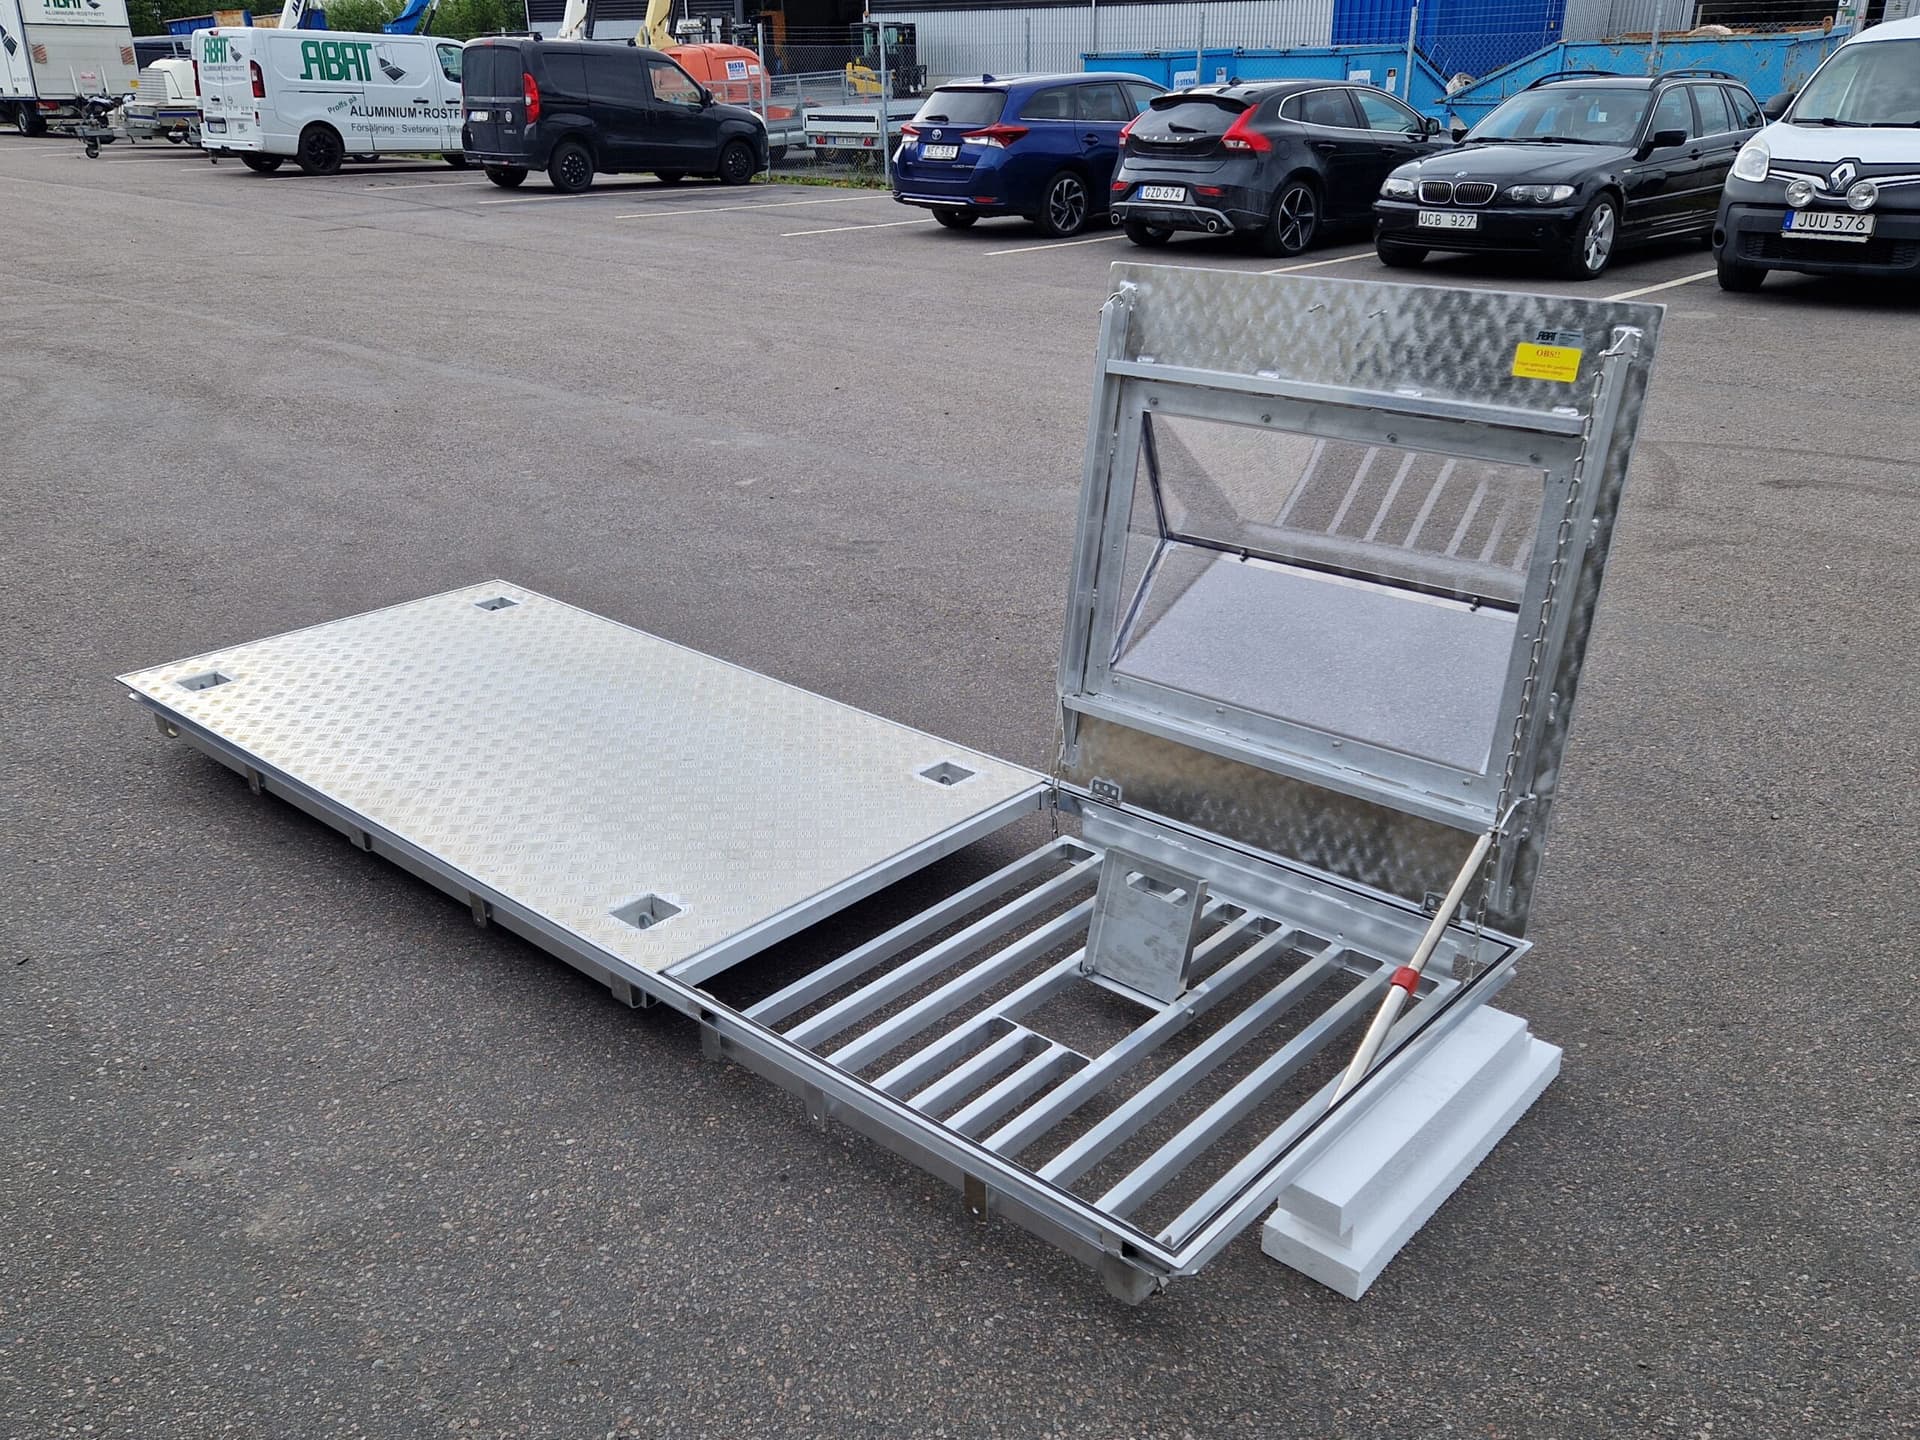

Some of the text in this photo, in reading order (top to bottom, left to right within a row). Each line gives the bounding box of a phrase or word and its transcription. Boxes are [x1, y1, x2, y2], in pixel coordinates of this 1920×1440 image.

[203, 37, 229, 64] ABAT
[299, 40, 373, 82] ABAT
[327, 99, 348, 114] Proffs
[401, 124, 439, 136] Svetsning
[1145, 187, 1180, 199] GZD 674
[1420, 212, 1475, 227] UCB 927
[1798, 213, 1866, 231] JUU 576
